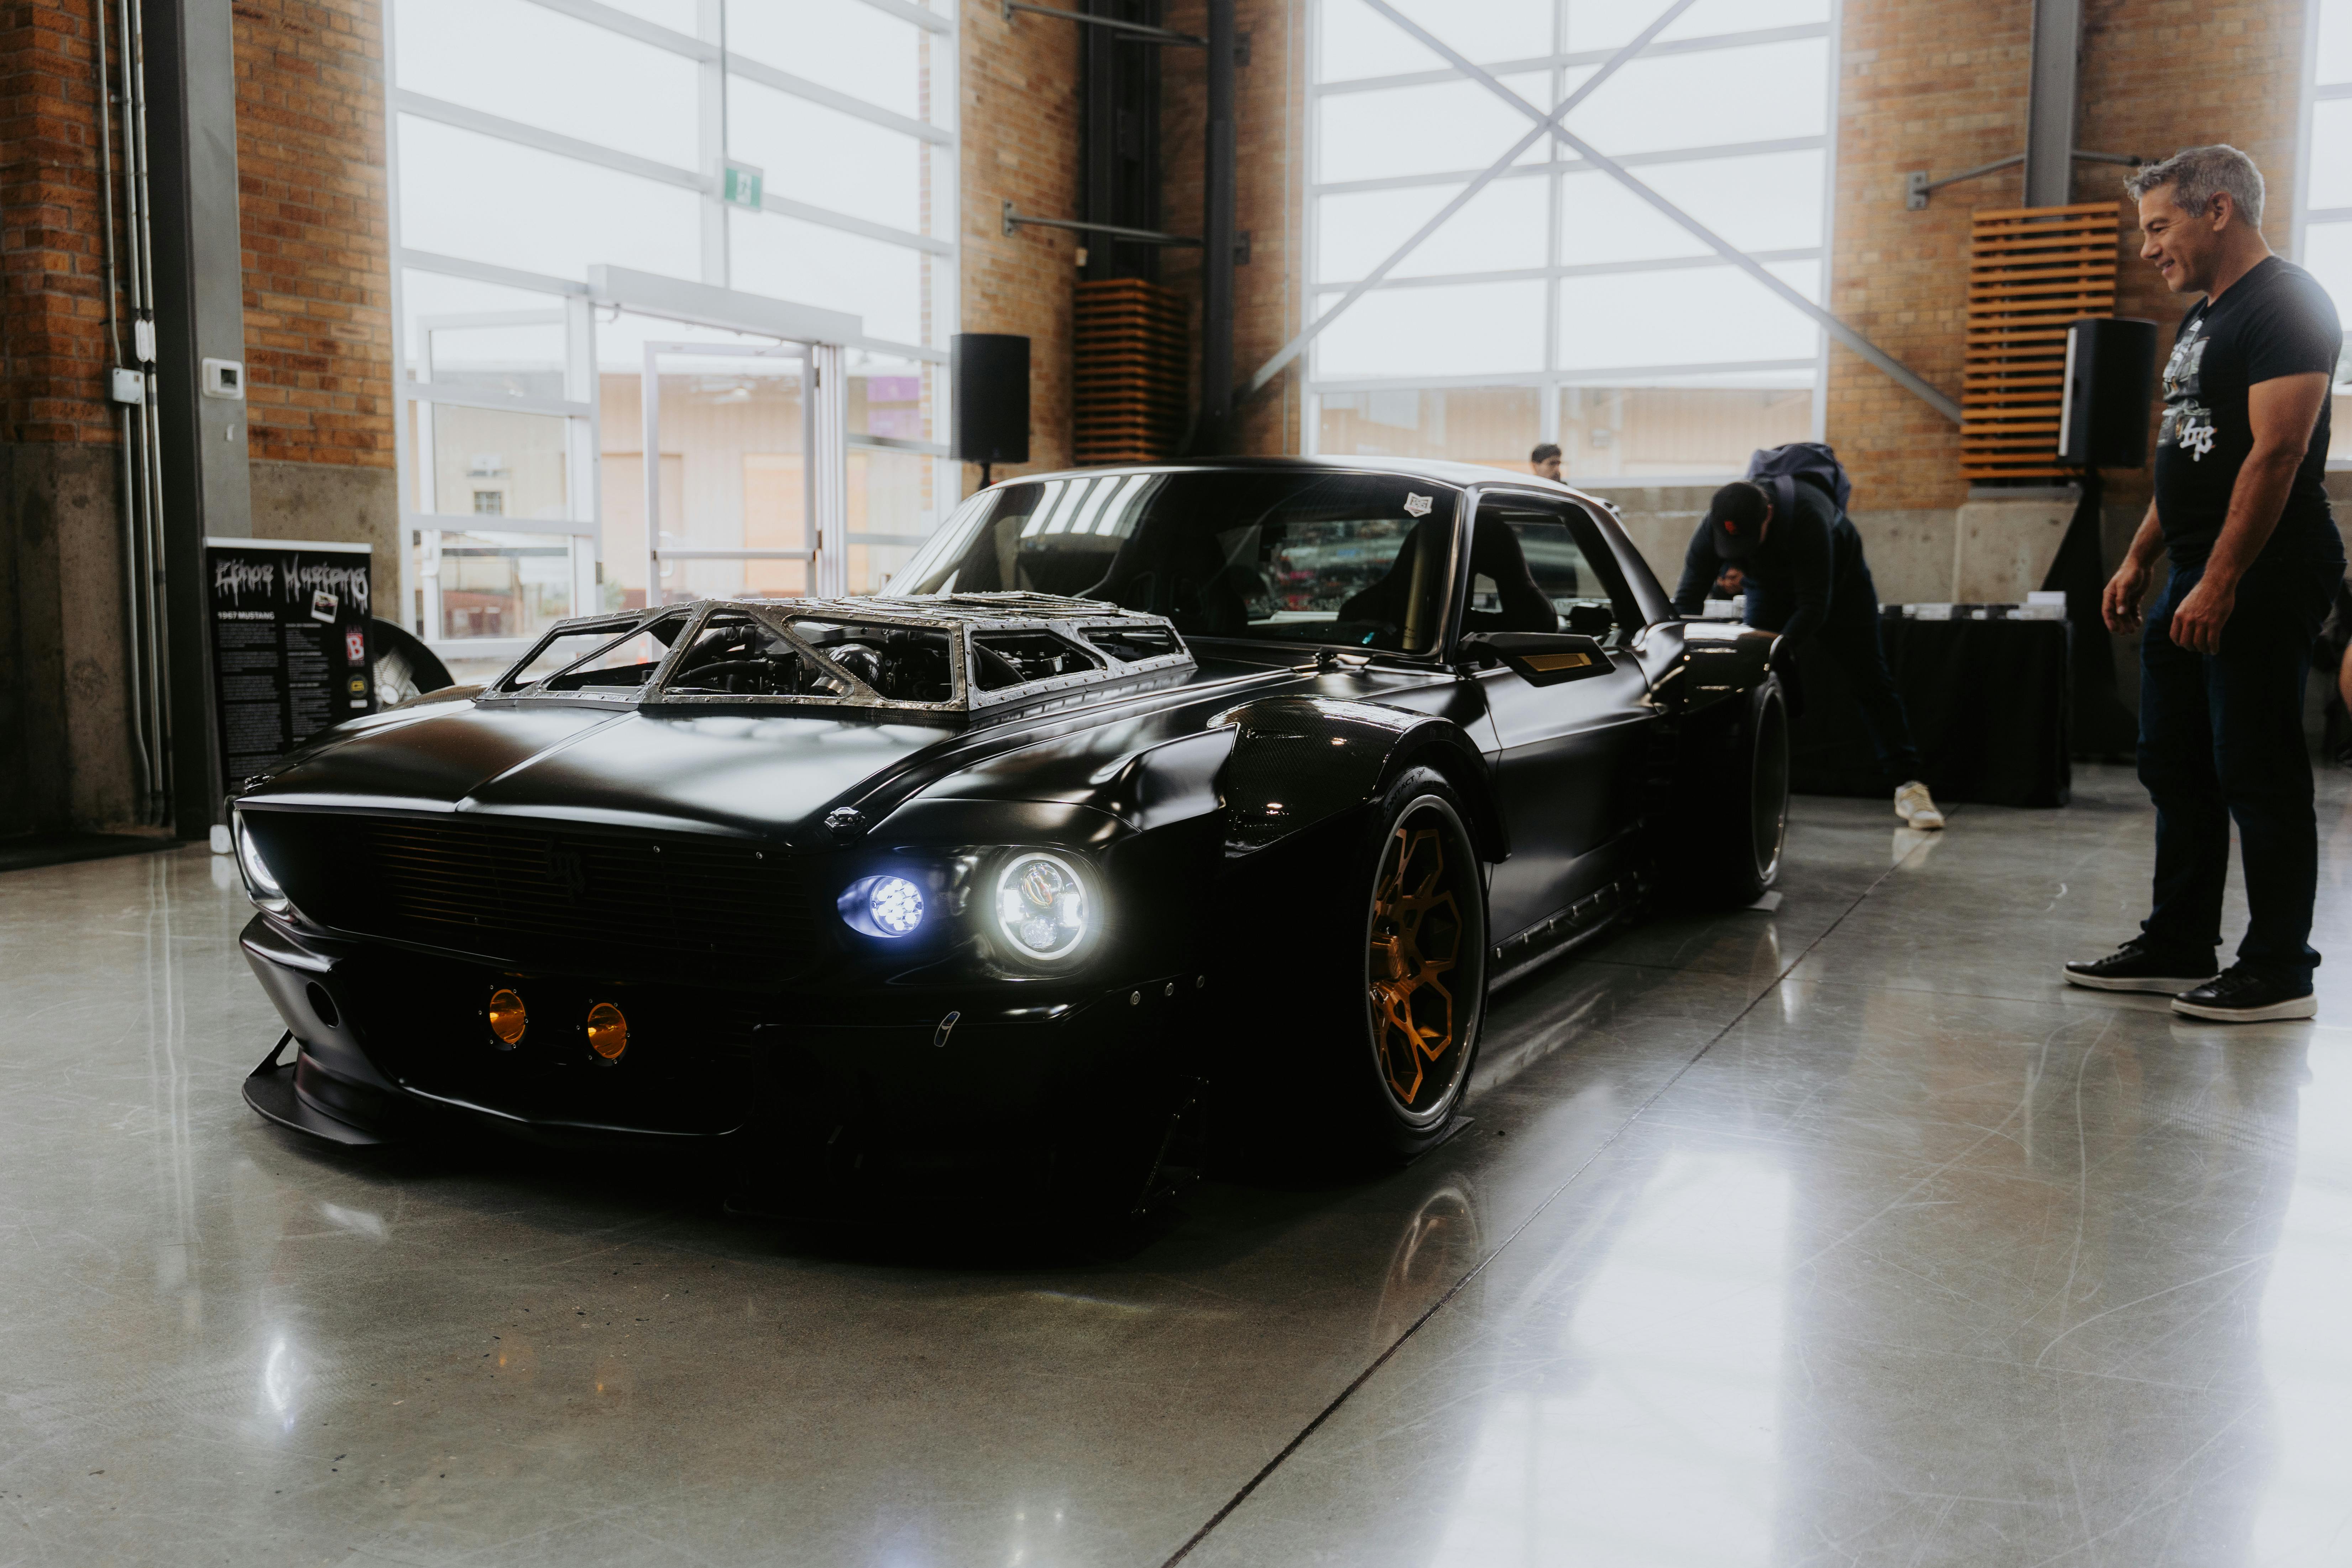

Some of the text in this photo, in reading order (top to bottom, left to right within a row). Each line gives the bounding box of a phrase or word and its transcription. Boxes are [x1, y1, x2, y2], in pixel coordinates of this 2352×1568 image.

[218, 611, 275, 620] 1967 MUSTANG
[1383, 775, 1415, 819] CONTACT
